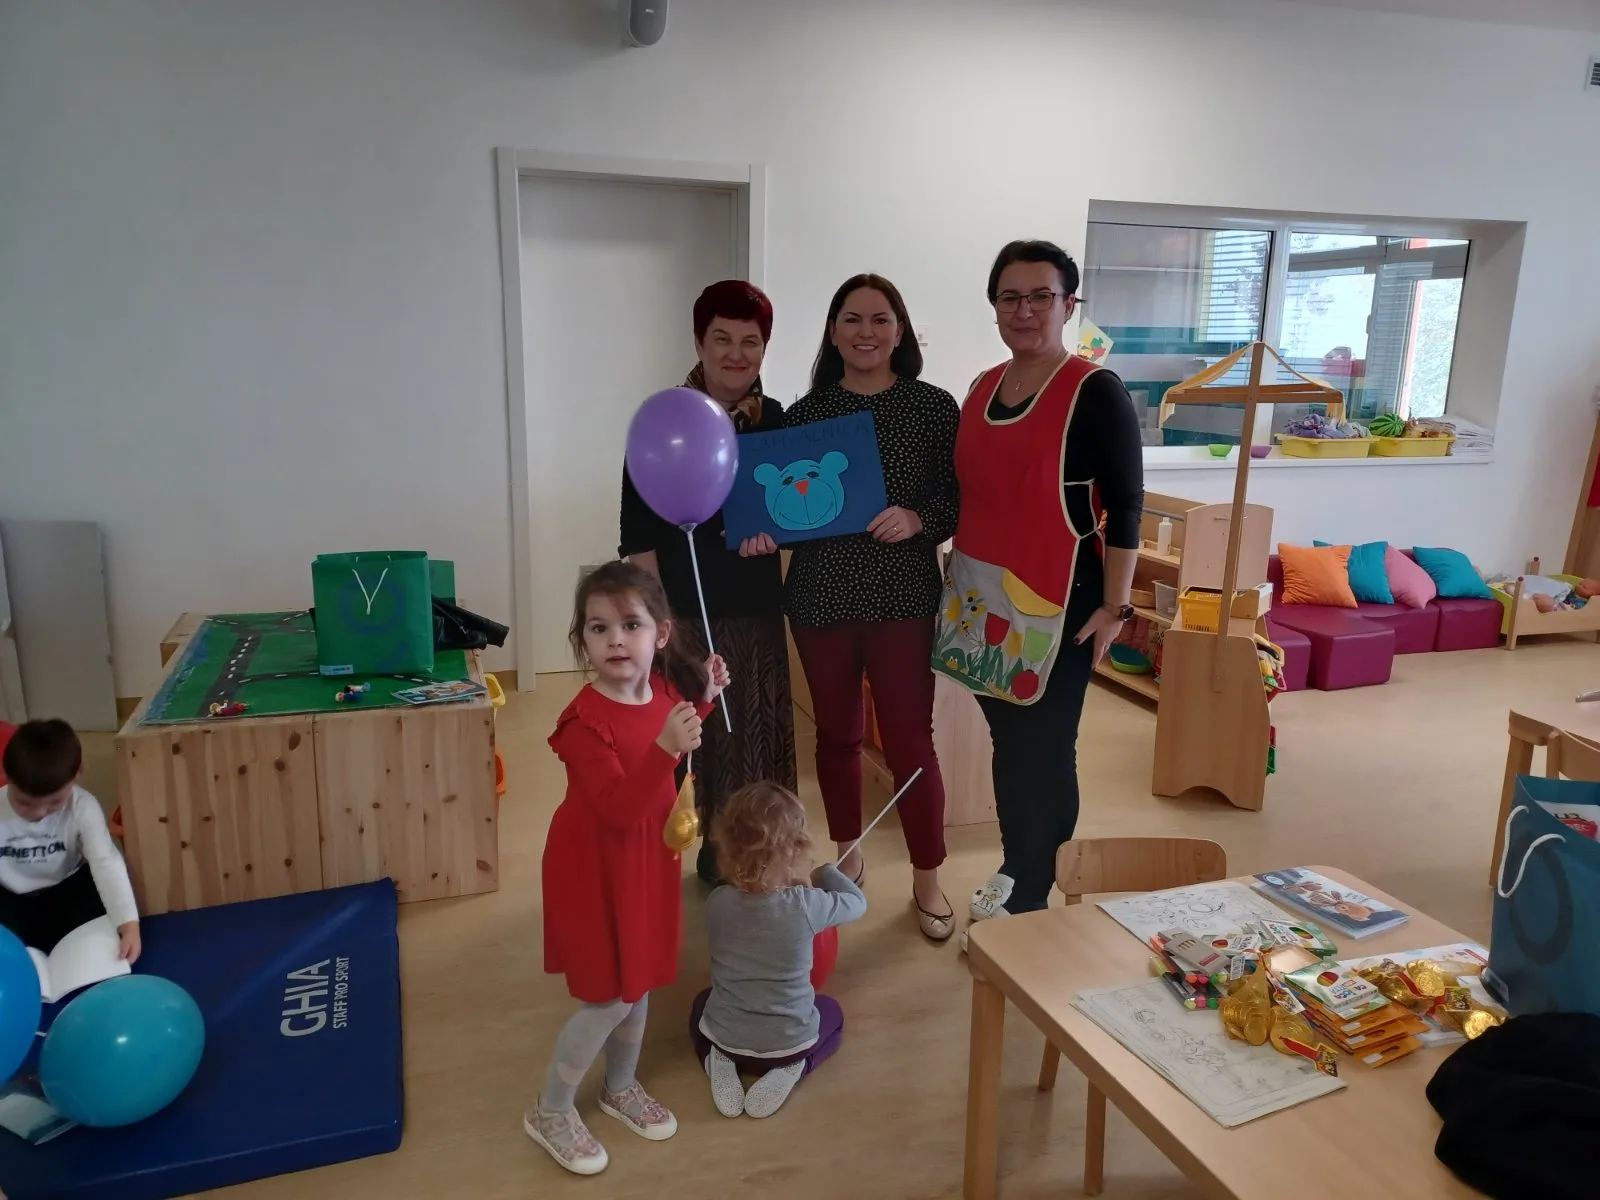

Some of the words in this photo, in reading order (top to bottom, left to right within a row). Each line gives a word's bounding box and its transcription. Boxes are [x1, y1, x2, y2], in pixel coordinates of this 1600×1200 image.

[335, 956, 350, 982] SPORT
[280, 958, 331, 1036] GHIA
[334, 982, 349, 1001] PRO
[333, 1000, 348, 1029] STAFF
